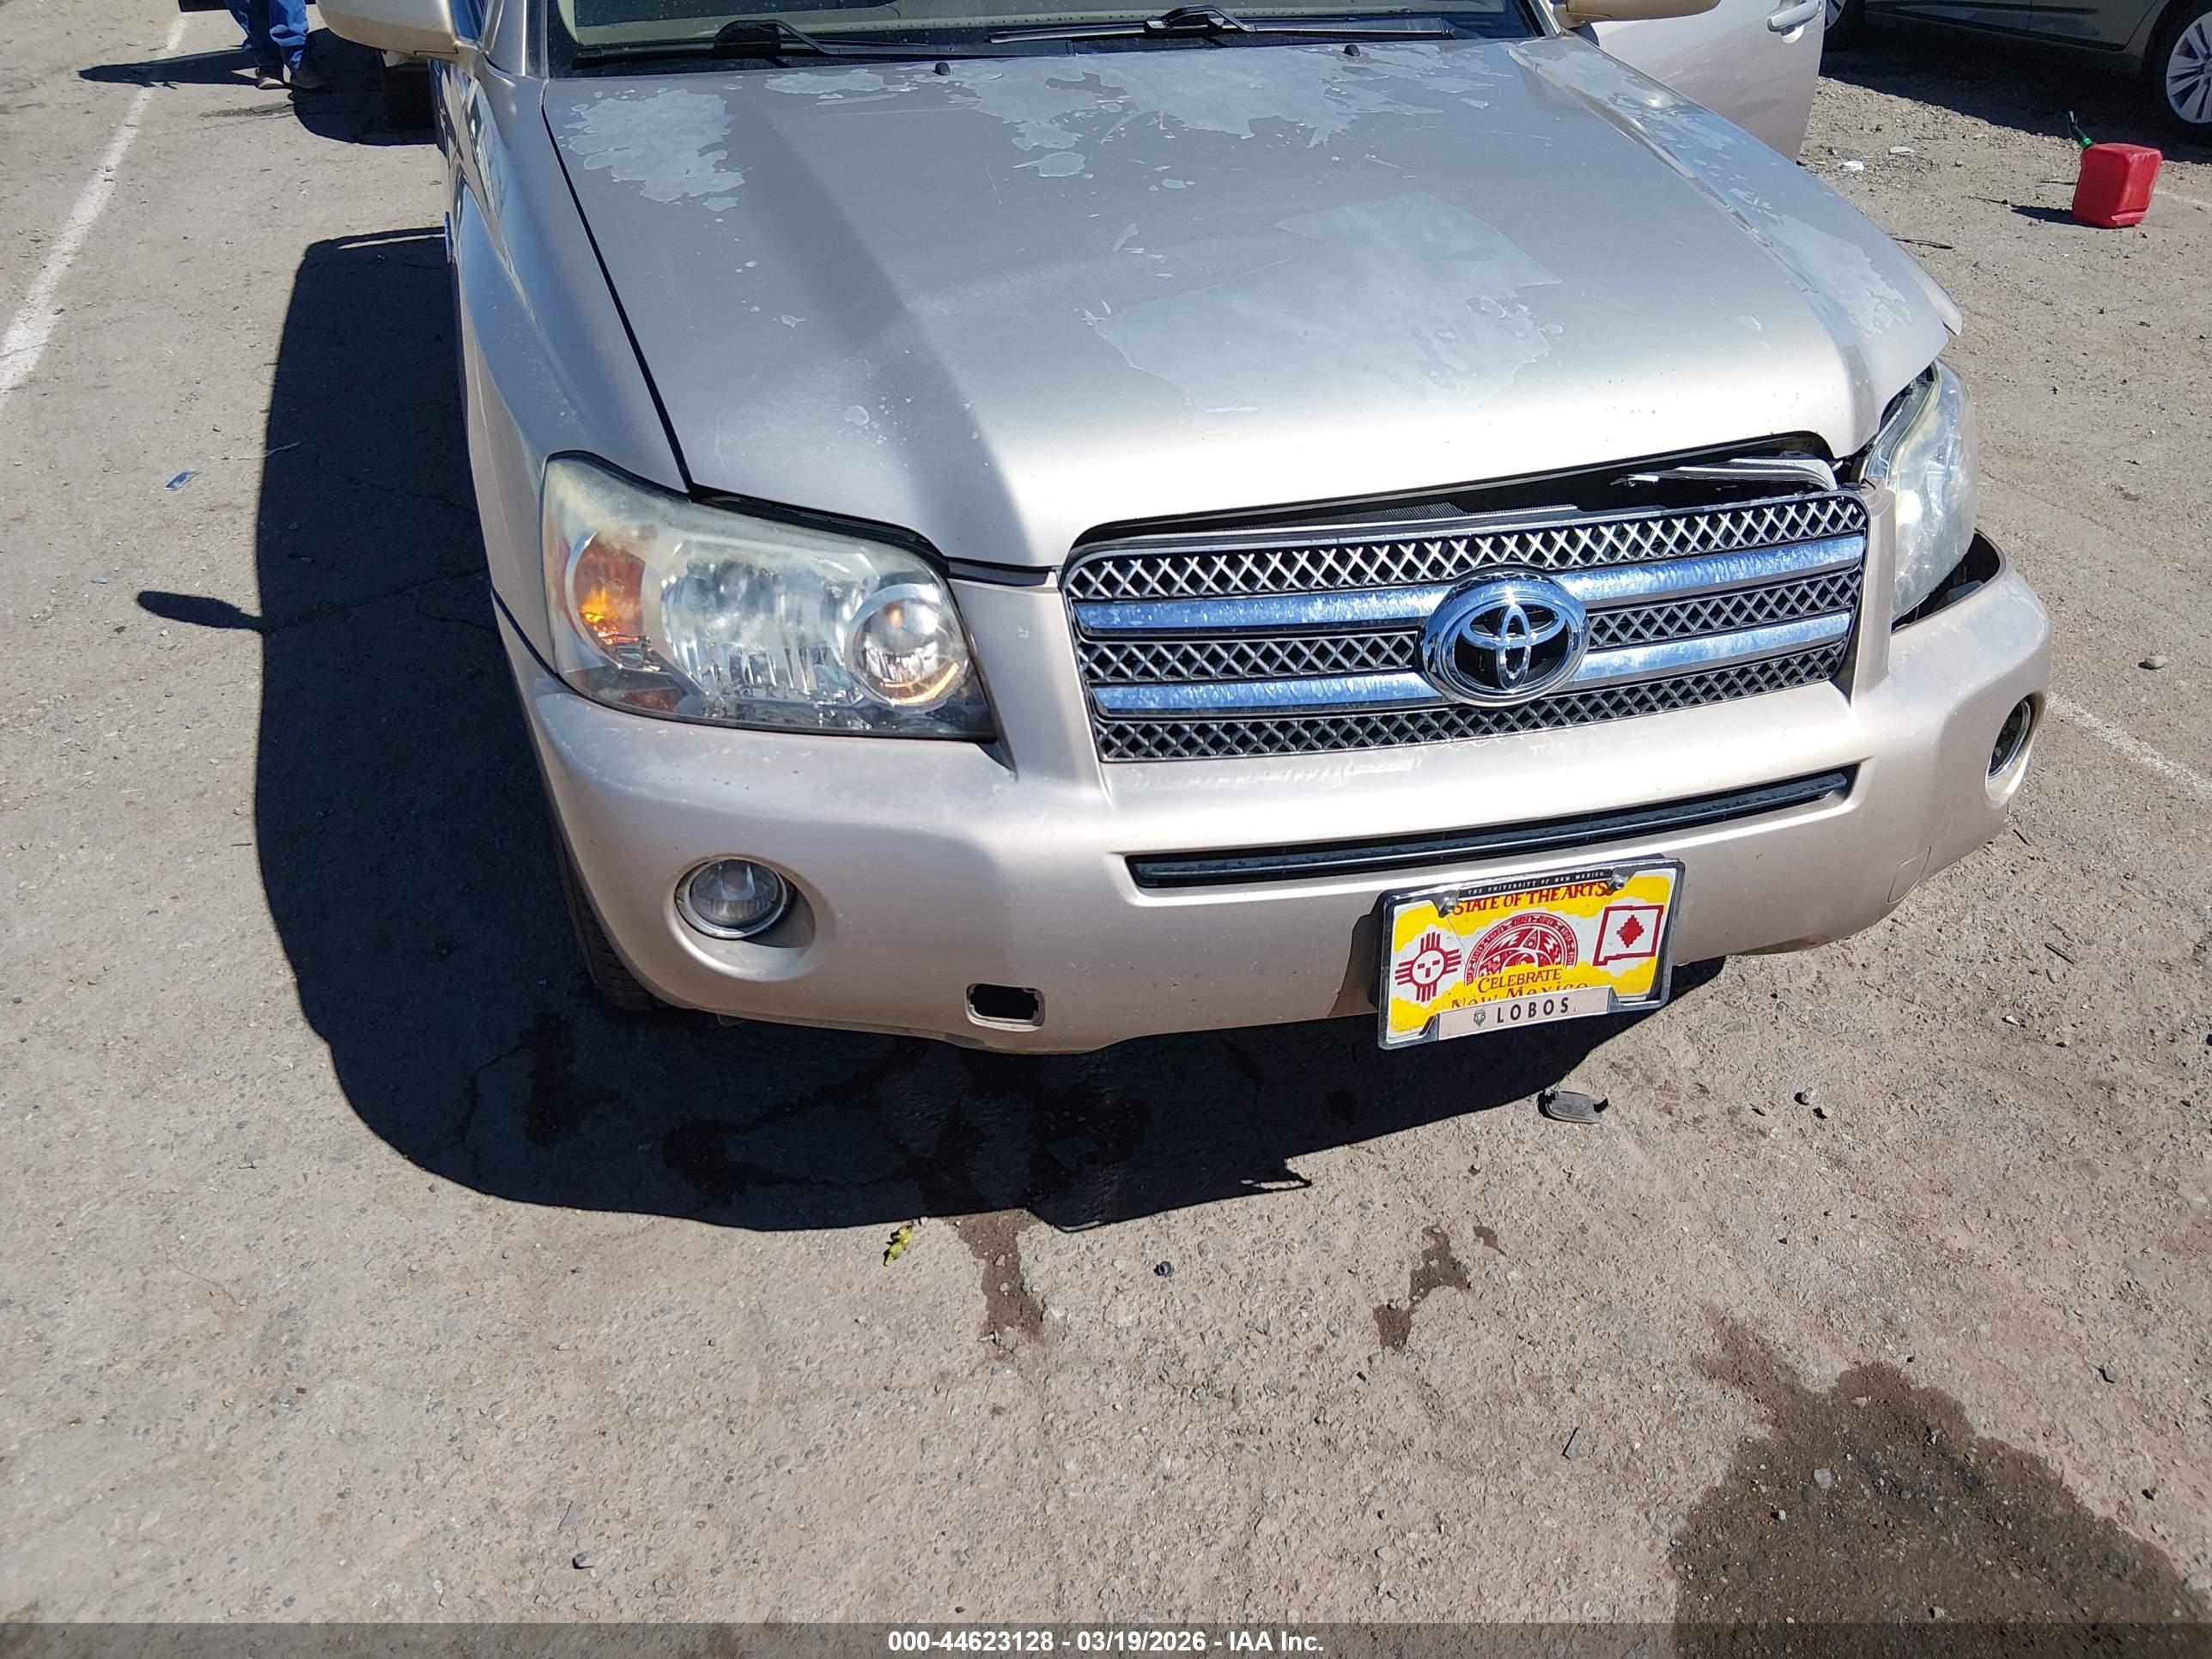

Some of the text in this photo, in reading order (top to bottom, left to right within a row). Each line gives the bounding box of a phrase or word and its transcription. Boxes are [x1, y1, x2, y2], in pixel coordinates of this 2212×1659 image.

[1453, 880, 1609, 915] STATE OF THE ARTS
[1497, 997, 1569, 1024] LOBOS
